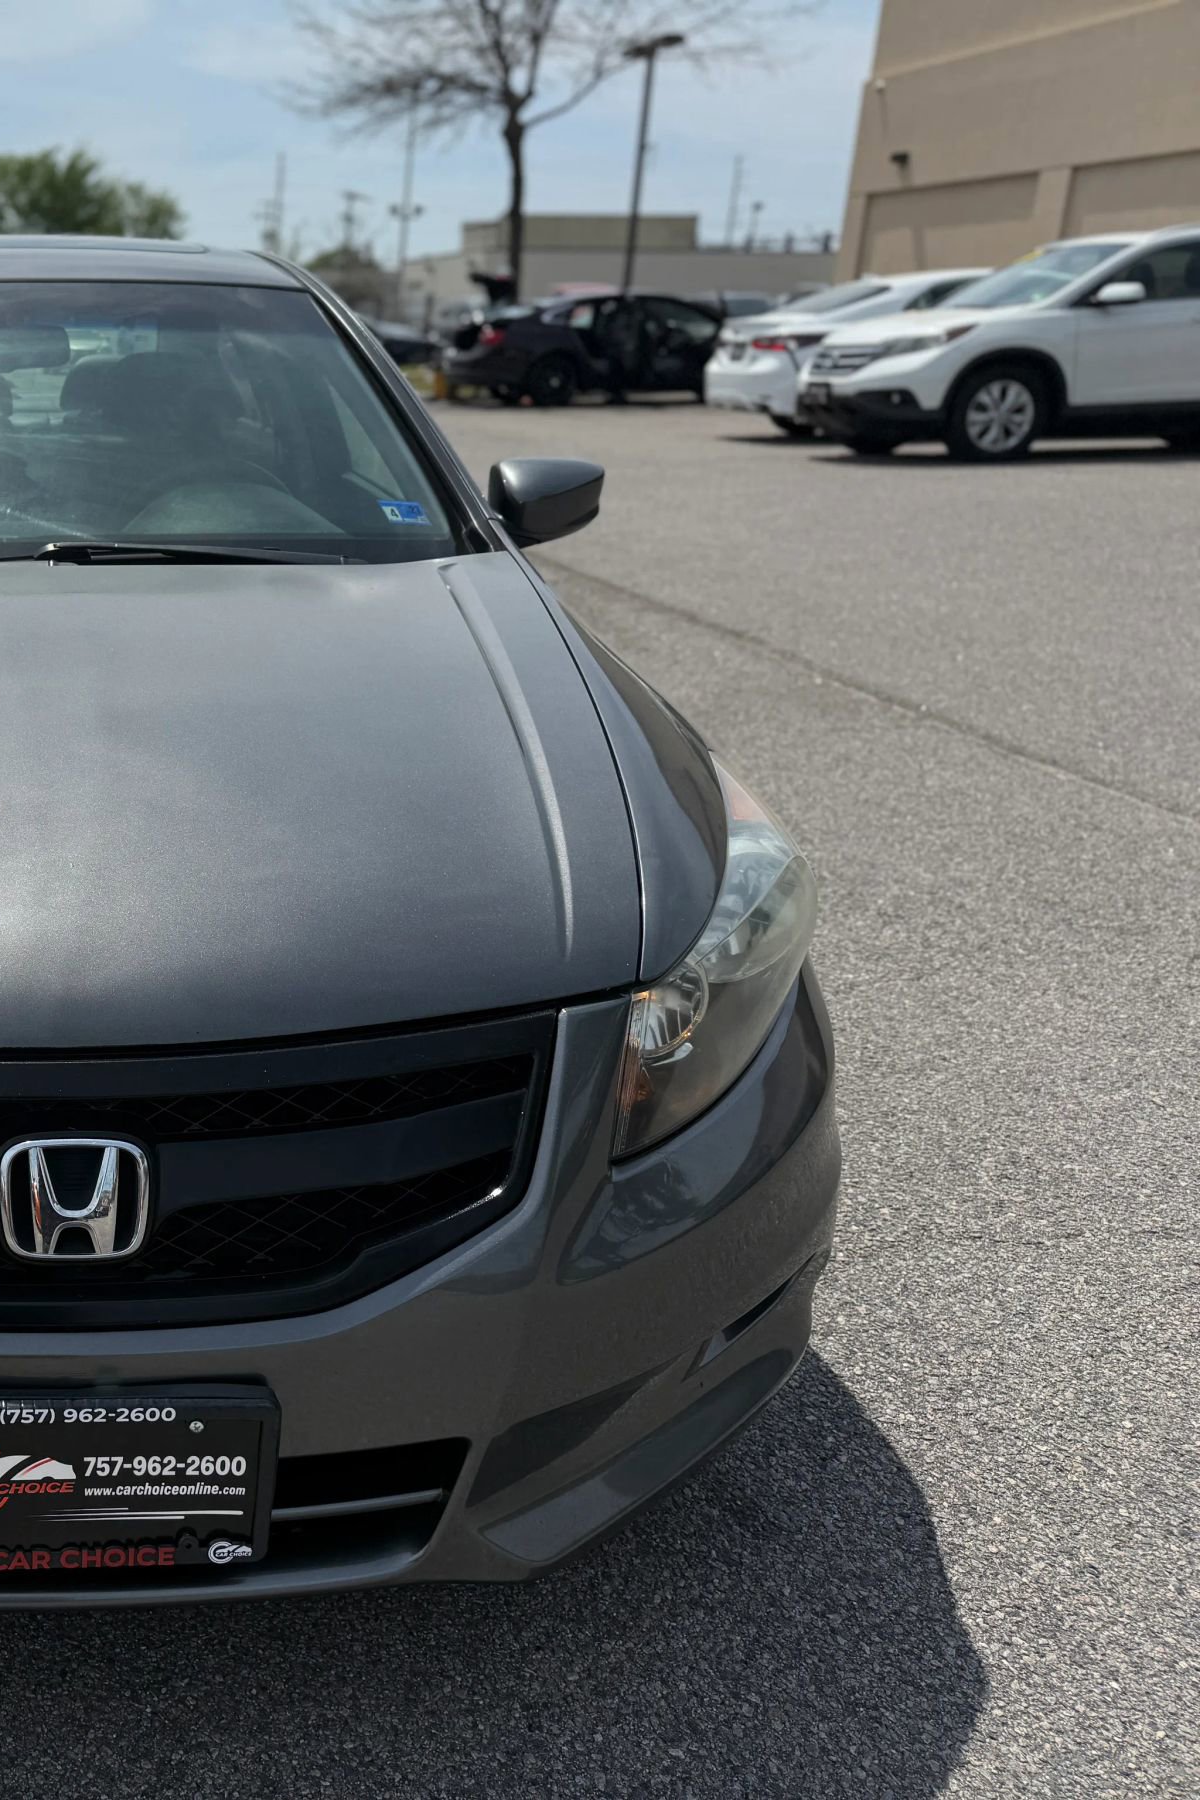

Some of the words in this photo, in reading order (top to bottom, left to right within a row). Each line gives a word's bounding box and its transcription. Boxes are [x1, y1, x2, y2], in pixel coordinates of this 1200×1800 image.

[0, 1408, 56, 1425] (757)
[63, 1407, 177, 1423] 962-2600
[83, 1455, 247, 1477] 757-962-2600
[84, 1482, 246, 1497] www.carchoiceonline.com
[59, 1546, 176, 1569] CHOICE
